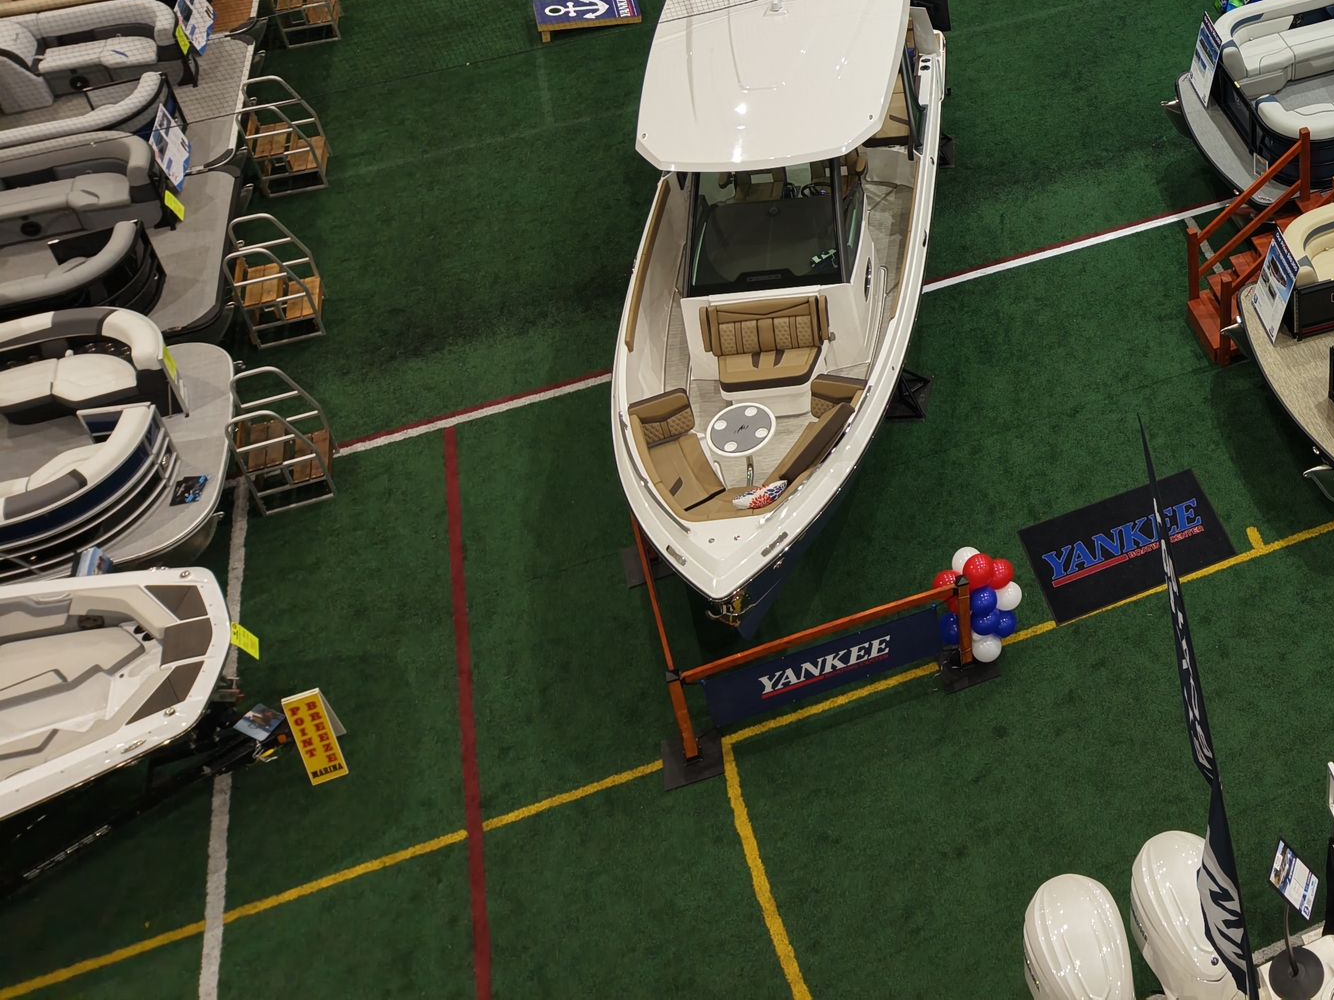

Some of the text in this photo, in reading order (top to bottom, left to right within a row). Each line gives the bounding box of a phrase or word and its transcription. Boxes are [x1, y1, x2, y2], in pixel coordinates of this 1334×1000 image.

[1042, 498, 1202, 580] YANKEE
[1128, 525, 1204, 559] BOATIN CENTER
[758, 635, 891, 695] YANKEE
[825, 653, 889, 678] BOATING CENTER
[289, 706, 317, 758] POINT
[305, 701, 338, 763] BREEZE
[311, 763, 344, 779] MARINA
